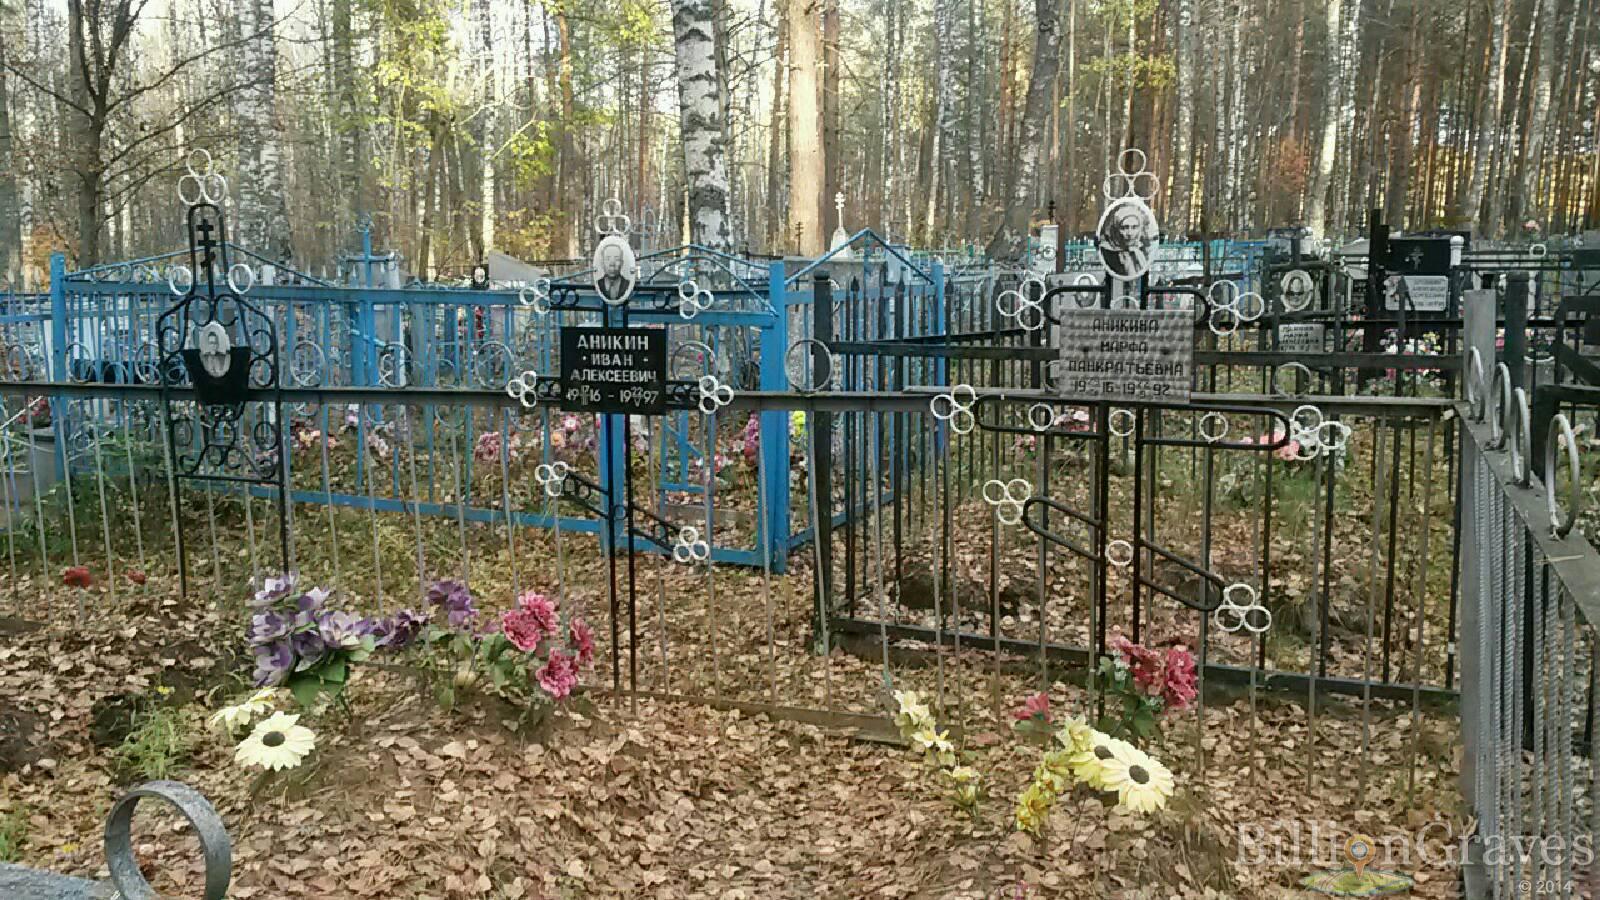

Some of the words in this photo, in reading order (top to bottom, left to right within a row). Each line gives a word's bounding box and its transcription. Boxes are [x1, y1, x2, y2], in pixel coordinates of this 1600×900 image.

[577, 334, 649, 350] АНИКИН
[591, 353, 634, 366] ИВАН
[1068, 360, 1184, 376] ПАНКРАТЬЕВНА
[570, 369, 657, 382] АЛЕКСЕЕВИЧ
